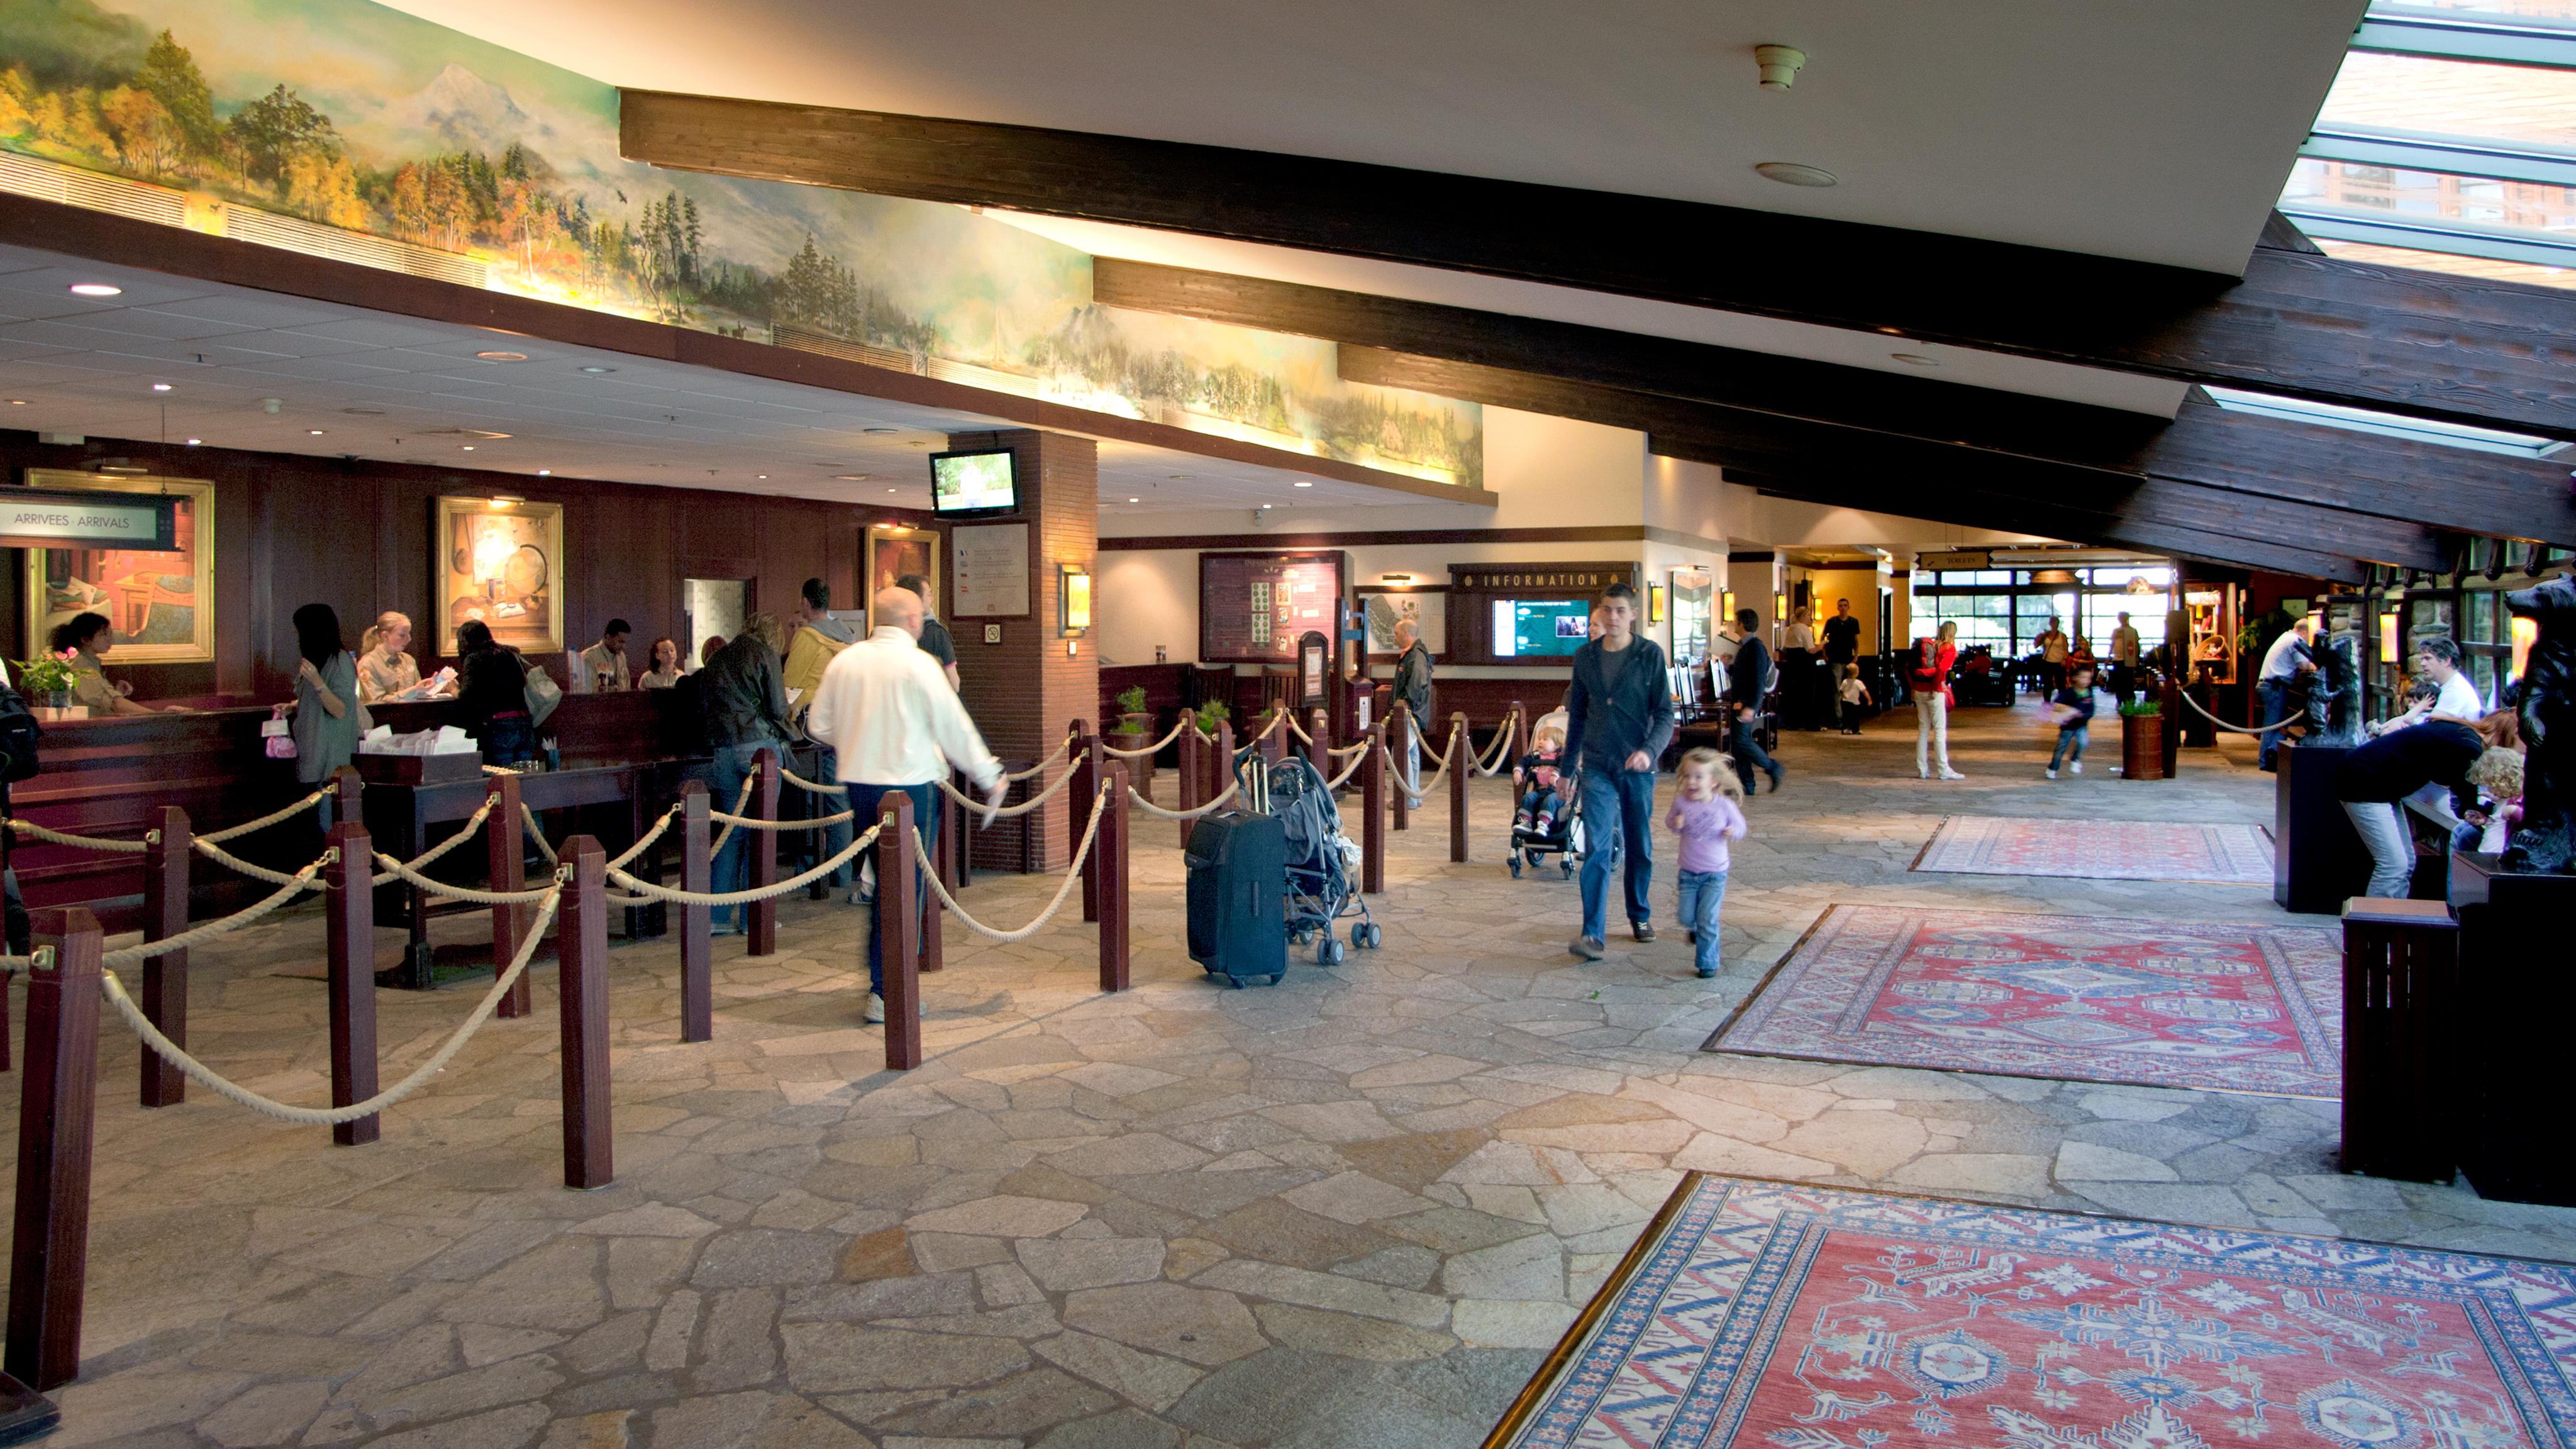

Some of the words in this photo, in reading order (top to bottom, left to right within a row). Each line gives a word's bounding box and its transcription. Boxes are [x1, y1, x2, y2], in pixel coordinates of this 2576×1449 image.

[14, 513, 69, 526] ARRIVEES
[77, 516, 130, 528] ARRIVALS
[1484, 574, 1597, 586] INFORMATION
